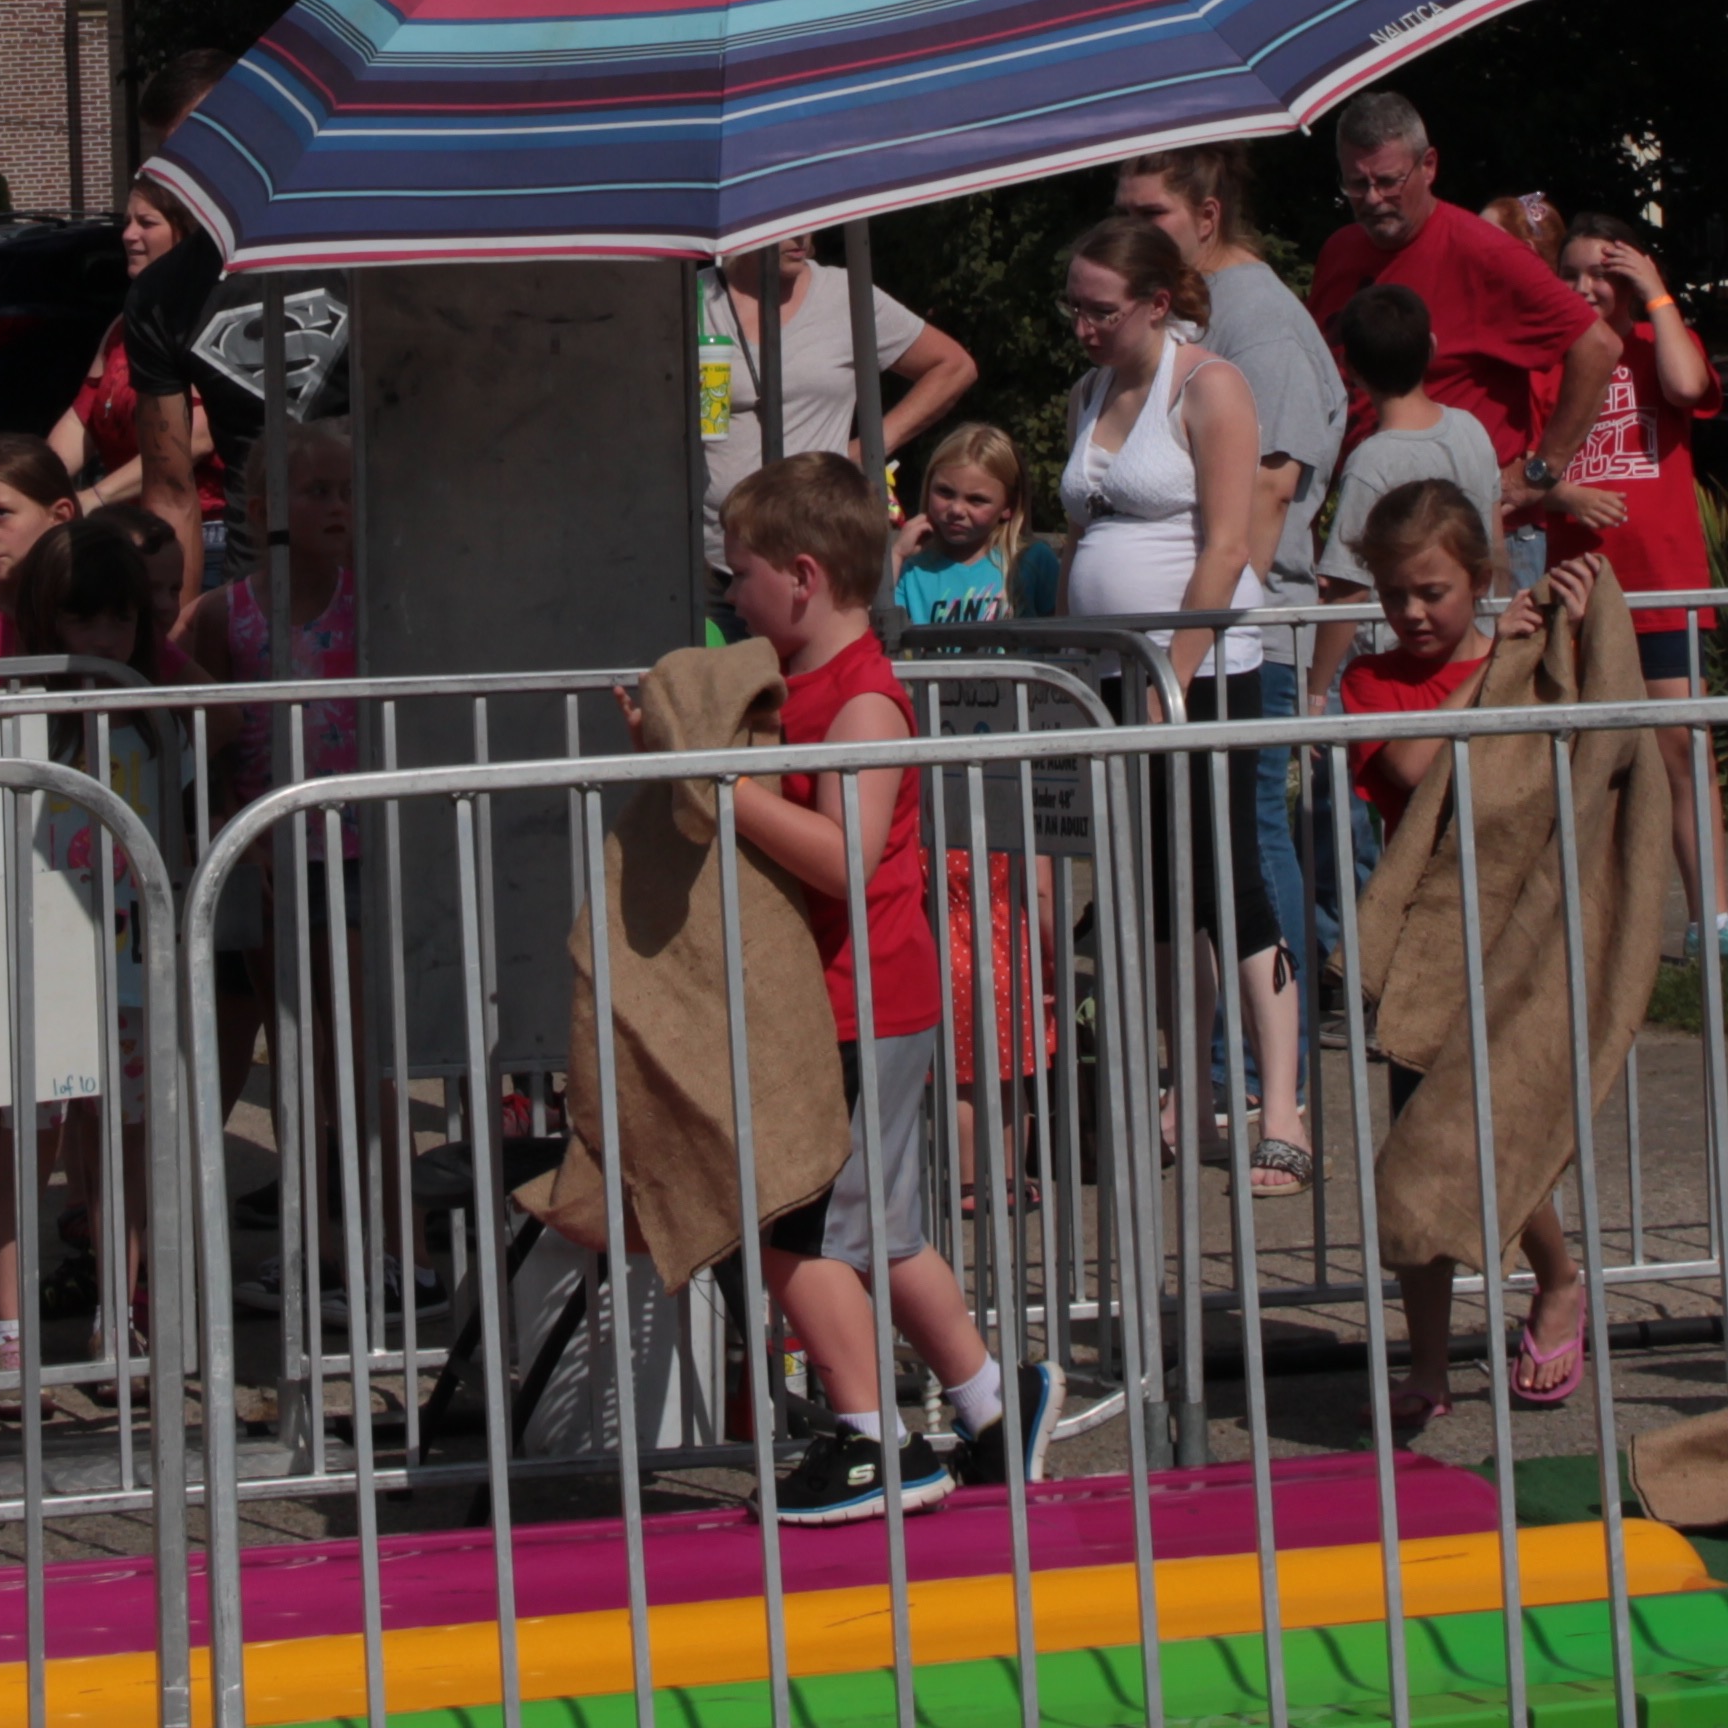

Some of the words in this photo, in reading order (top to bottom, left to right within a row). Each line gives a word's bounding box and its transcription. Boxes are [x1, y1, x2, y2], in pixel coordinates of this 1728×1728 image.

[1369, 1, 1444, 46] NAUTICA
[1060, 816, 1089, 837] ADULT
[79, 1075, 96, 1093] 10
[847, 1462, 876, 1486] S
